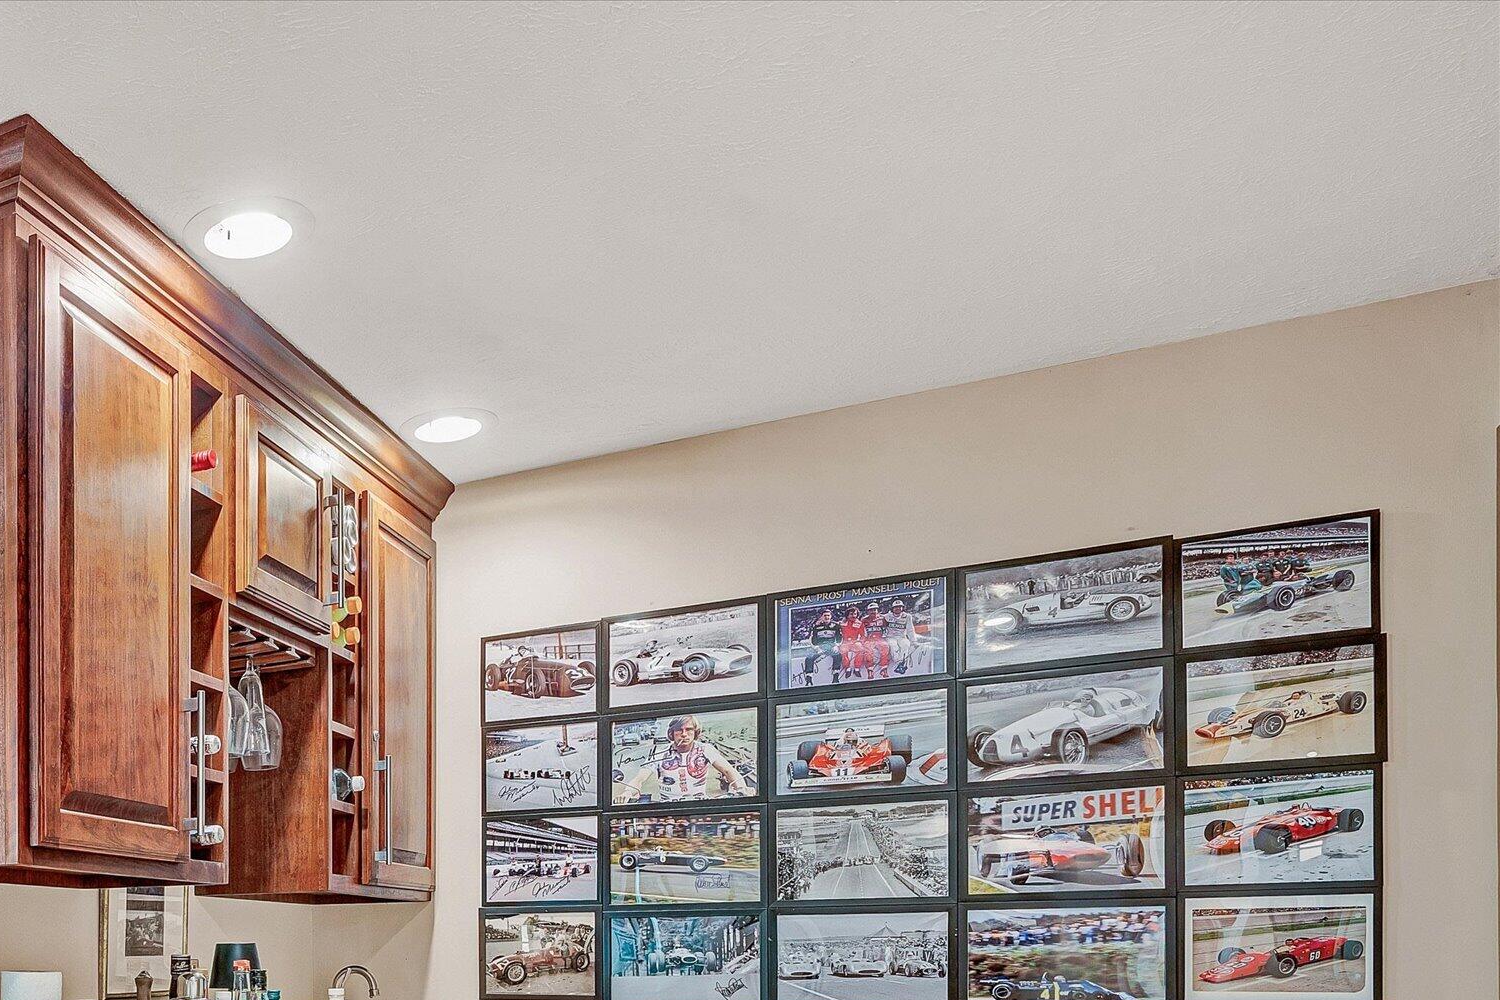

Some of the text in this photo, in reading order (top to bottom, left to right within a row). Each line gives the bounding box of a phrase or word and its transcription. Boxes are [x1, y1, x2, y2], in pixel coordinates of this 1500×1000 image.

[780, 576, 941, 607] SENNA PROST MANSELL PIQUET
[1294, 708, 1306, 720] 24
[1010, 734, 1030, 758] 4
[835, 768, 848, 776] 11
[1011, 800, 1077, 824] SUPER
[1298, 816, 1316, 827] 40
[1310, 950, 1321, 962] 60
